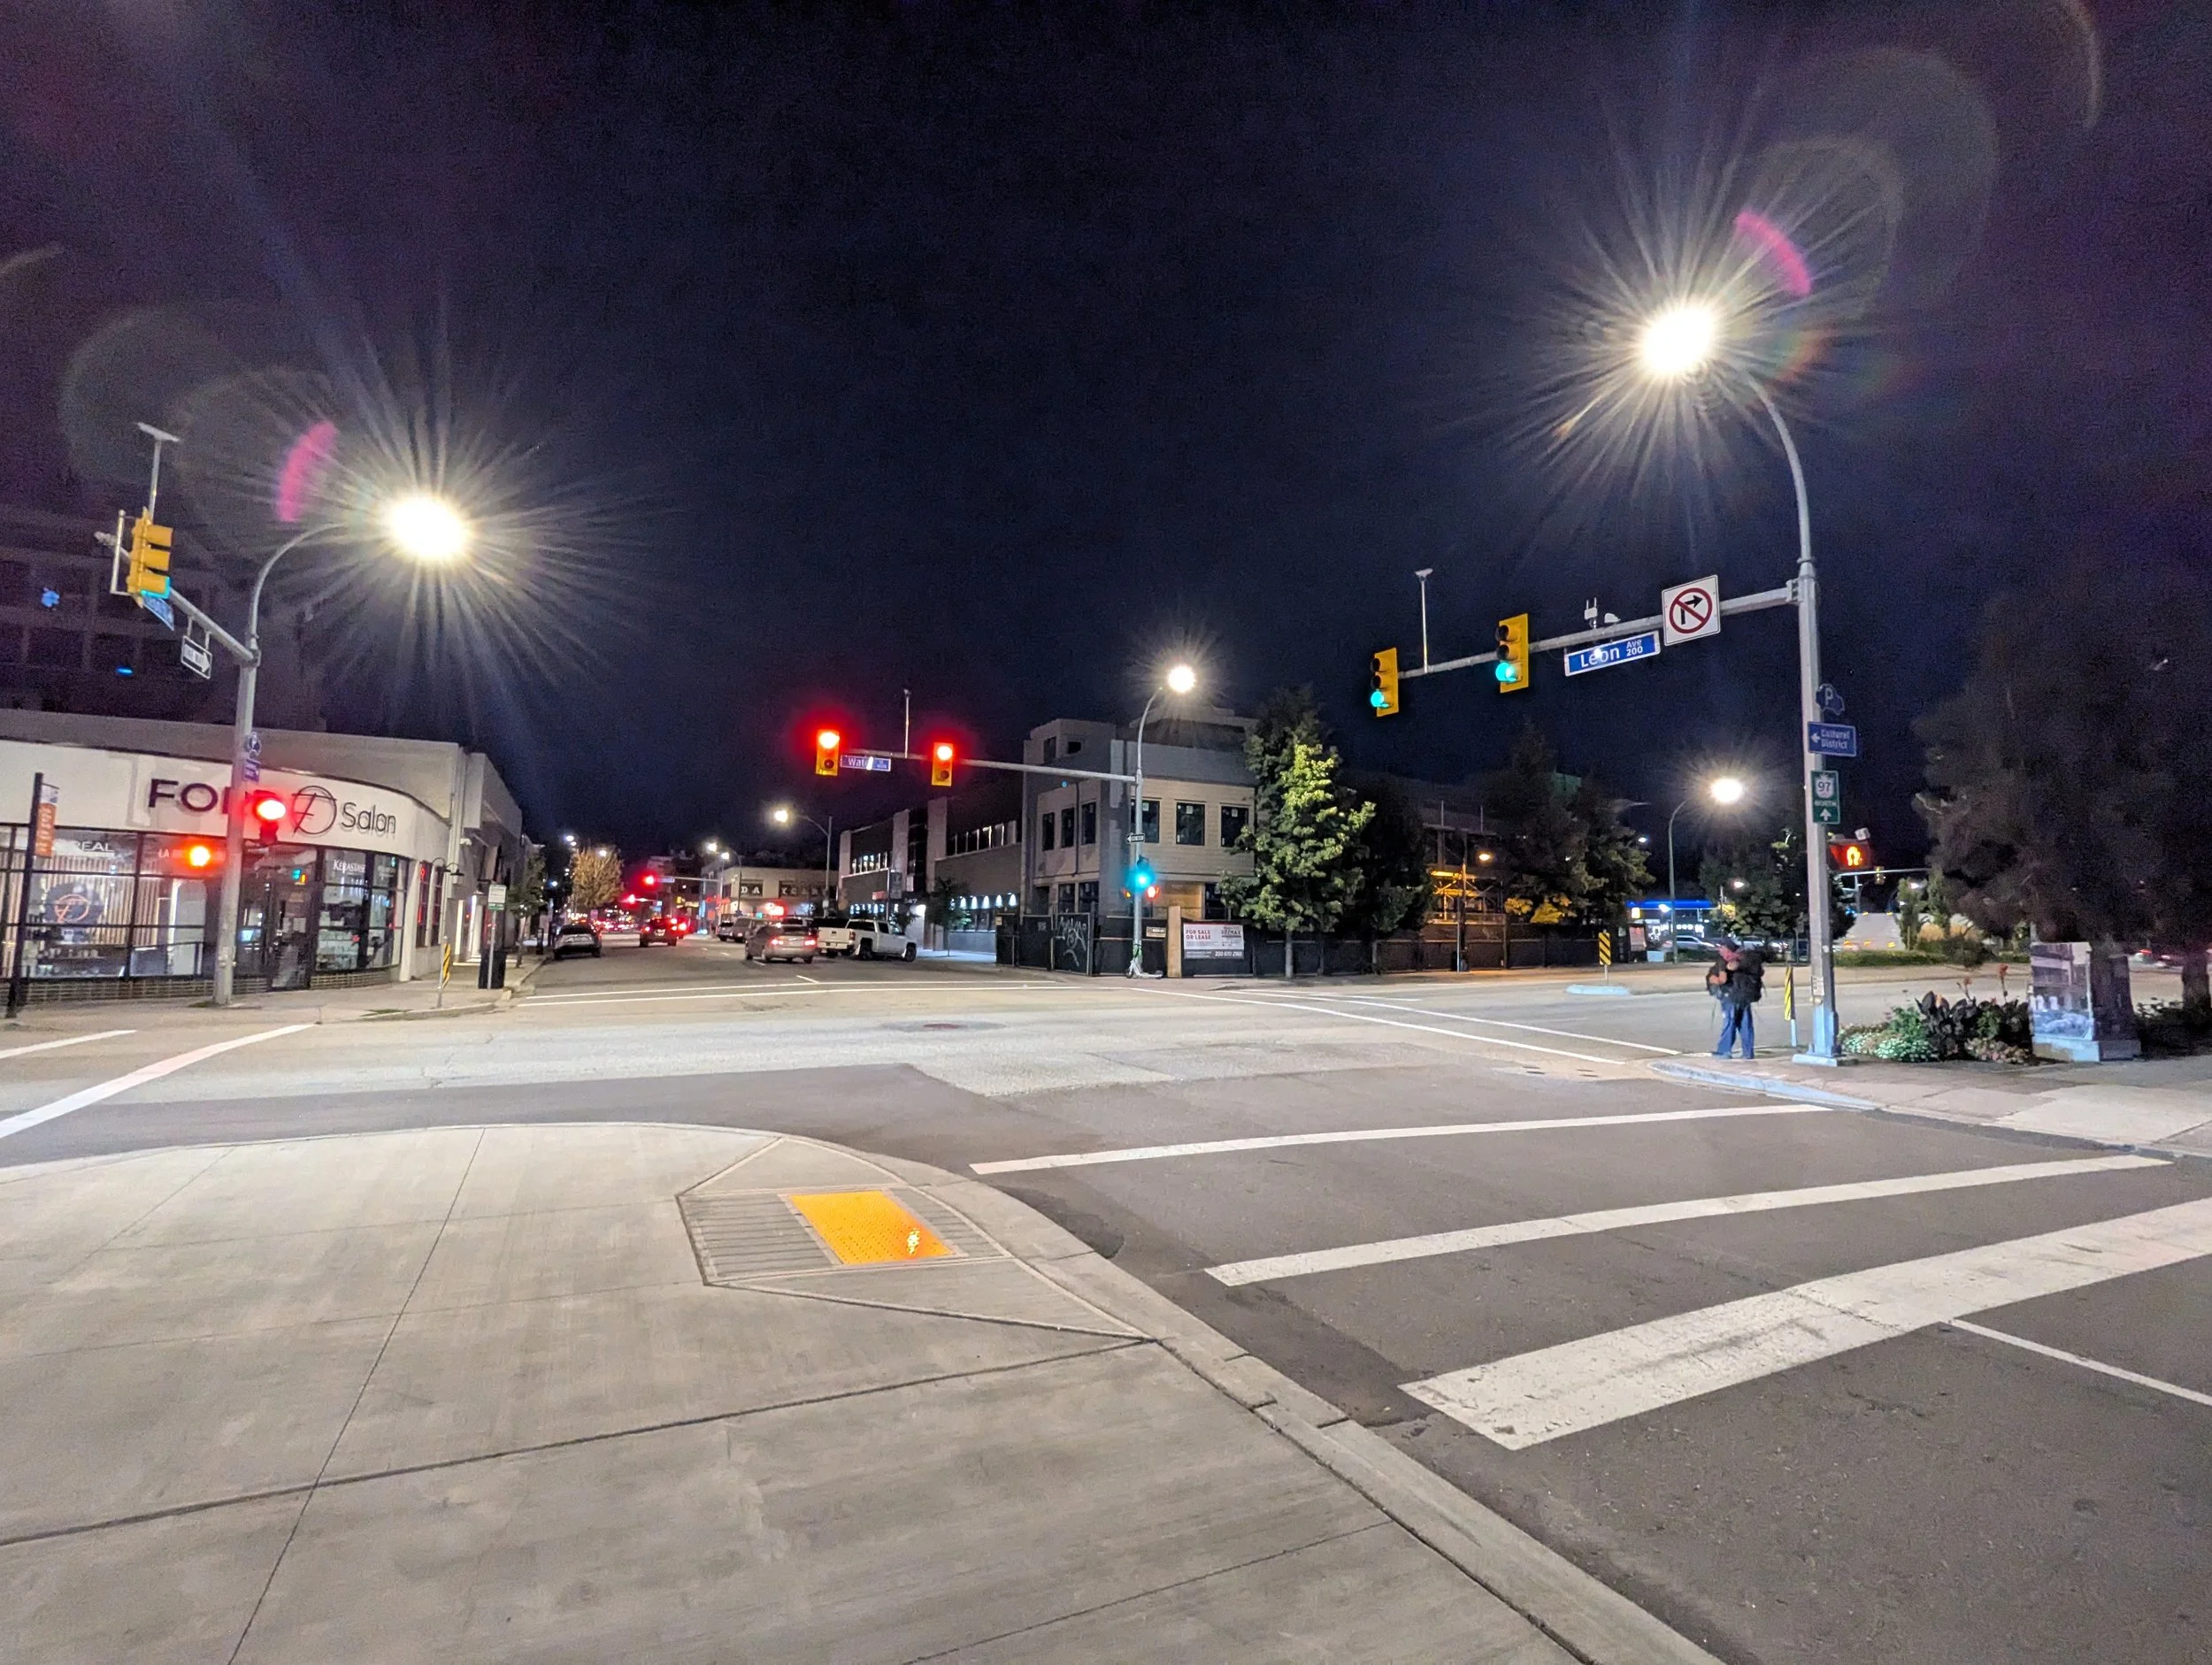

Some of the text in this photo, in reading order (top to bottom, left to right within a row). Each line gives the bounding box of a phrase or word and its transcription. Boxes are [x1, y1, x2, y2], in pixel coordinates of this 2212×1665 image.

[1626, 640, 1642, 648] Ave
[1626, 646, 1643, 656] 200
[1580, 648, 1620, 668] Leon
[1825, 687, 1833, 706] P
[1818, 781, 1831, 793] 97
[342, 802, 397, 834] Salon
